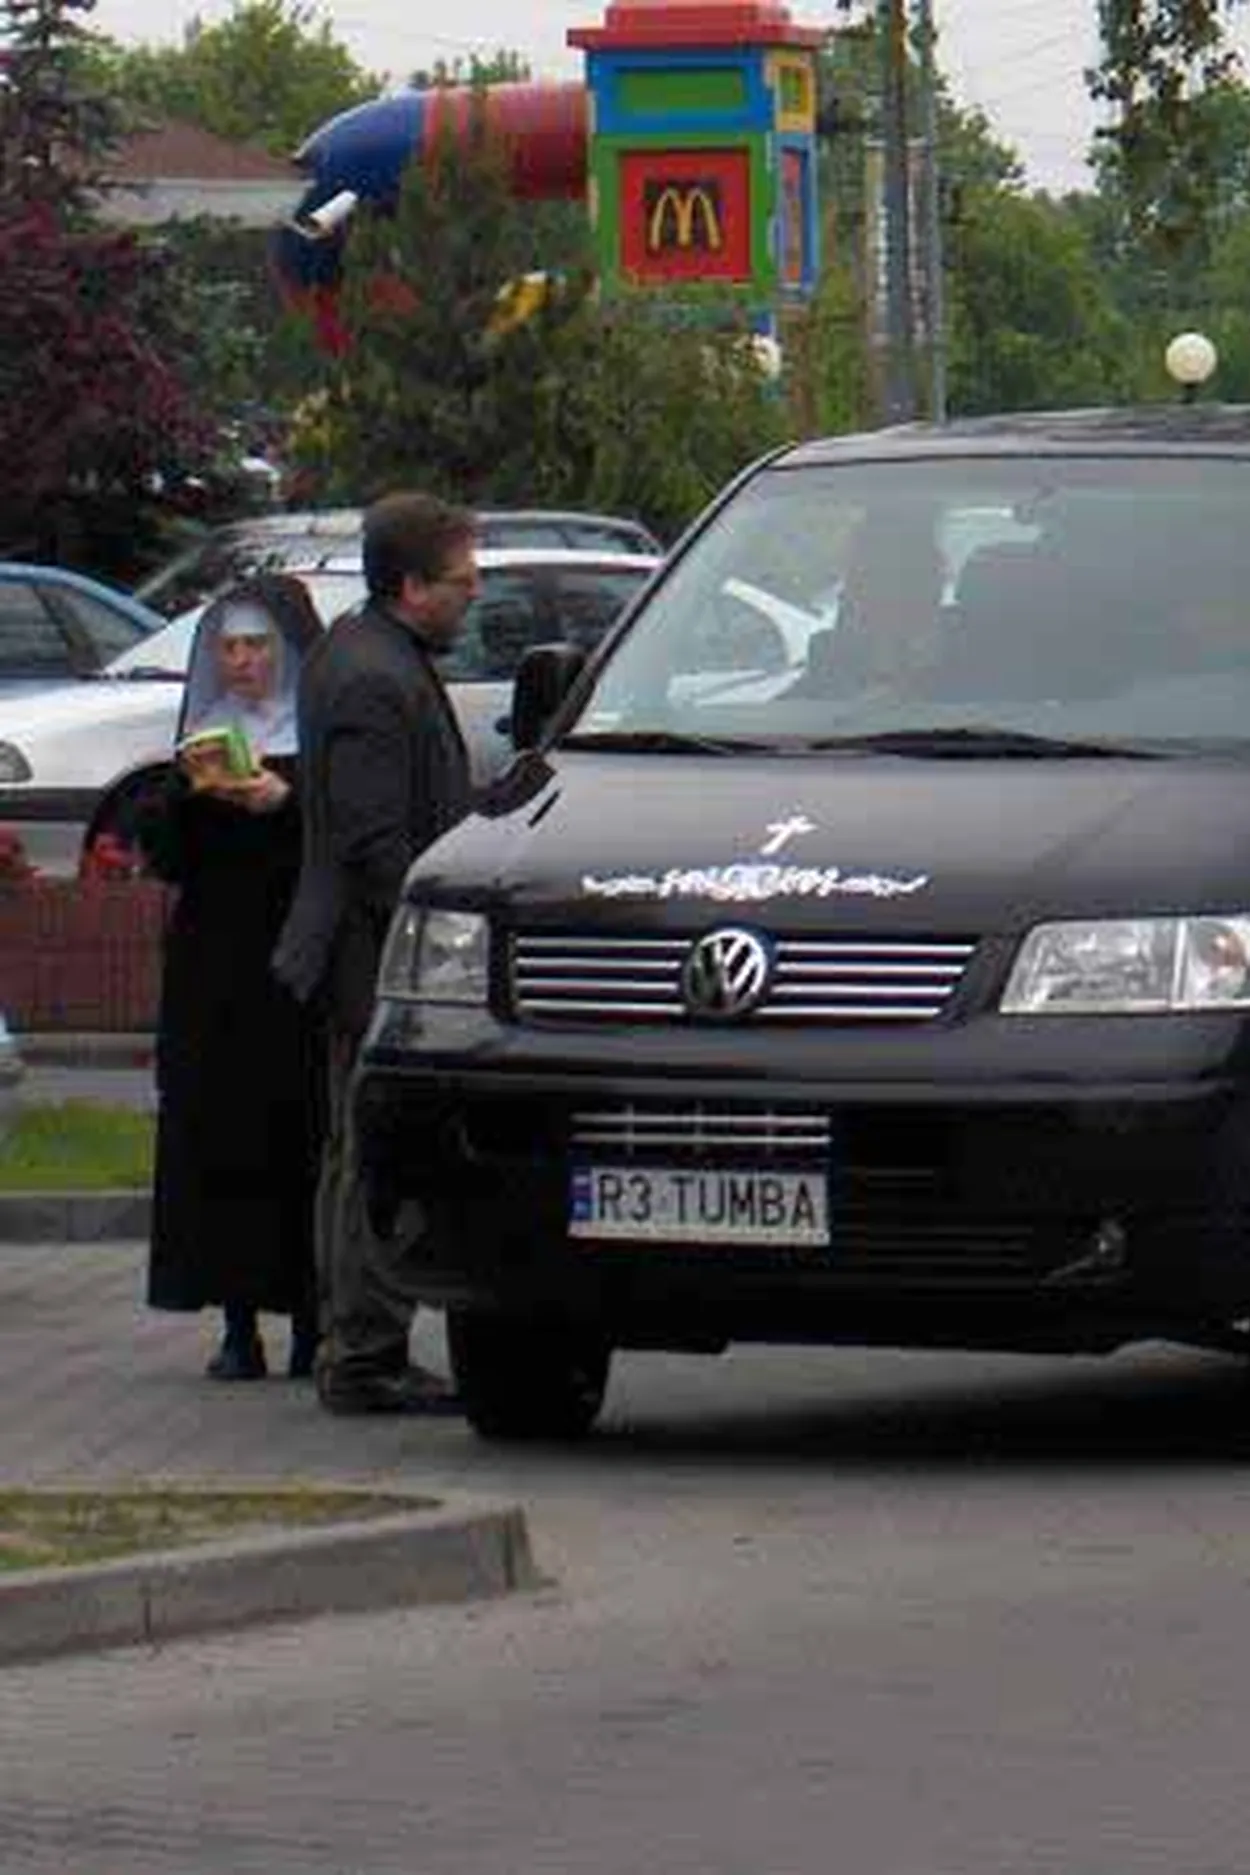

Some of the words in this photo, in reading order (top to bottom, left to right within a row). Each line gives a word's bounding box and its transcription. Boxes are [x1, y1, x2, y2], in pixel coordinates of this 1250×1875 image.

[650, 186, 721, 249] M
[598, 1173, 651, 1222] R3
[669, 1175, 817, 1229] TUMBA
